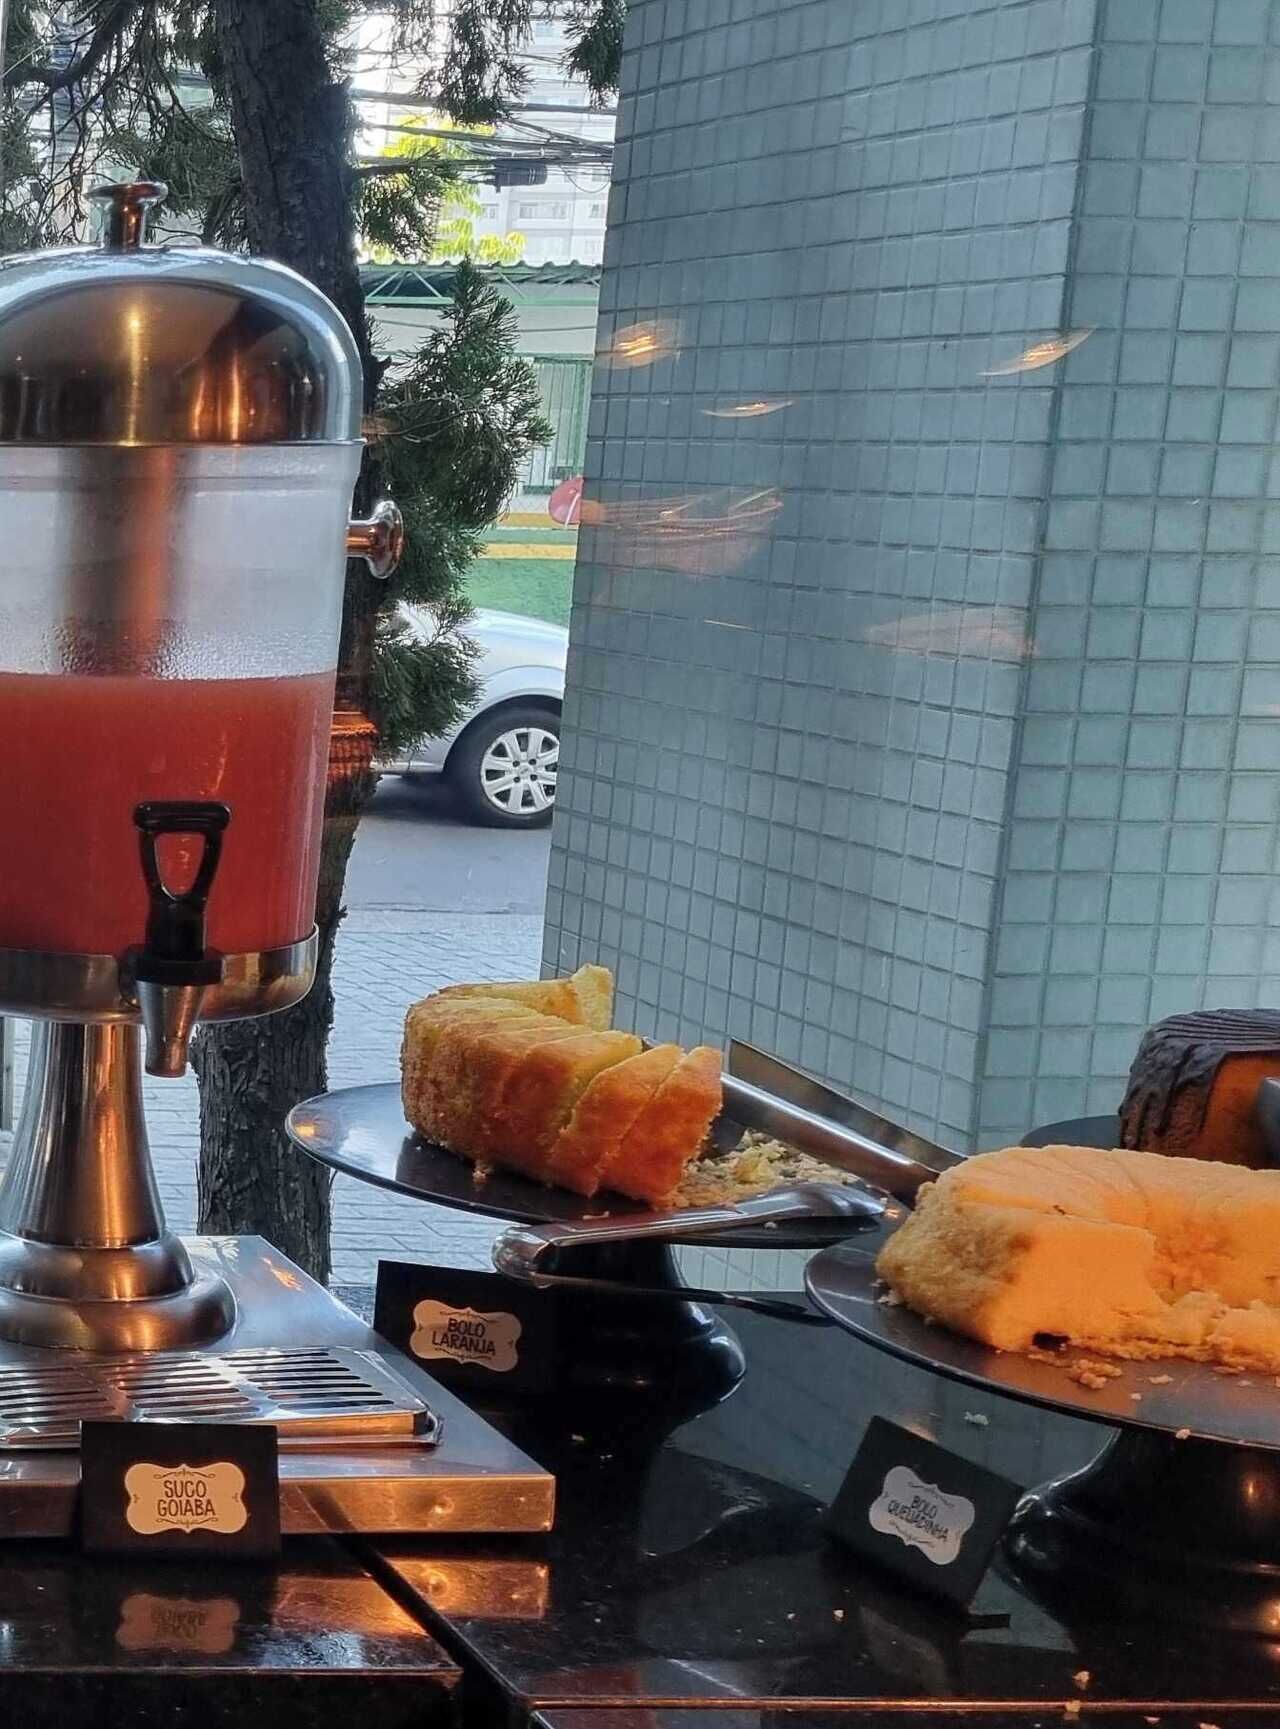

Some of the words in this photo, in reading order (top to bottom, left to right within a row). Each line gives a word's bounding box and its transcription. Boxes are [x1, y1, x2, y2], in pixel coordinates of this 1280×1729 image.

[448, 1317, 486, 1338] BOLO
[431, 1330, 496, 1357] LARANJA
[164, 1479, 207, 1498] SUCO
[156, 1499, 216, 1517] GOIABA
[911, 1495, 937, 1519] BOLO
